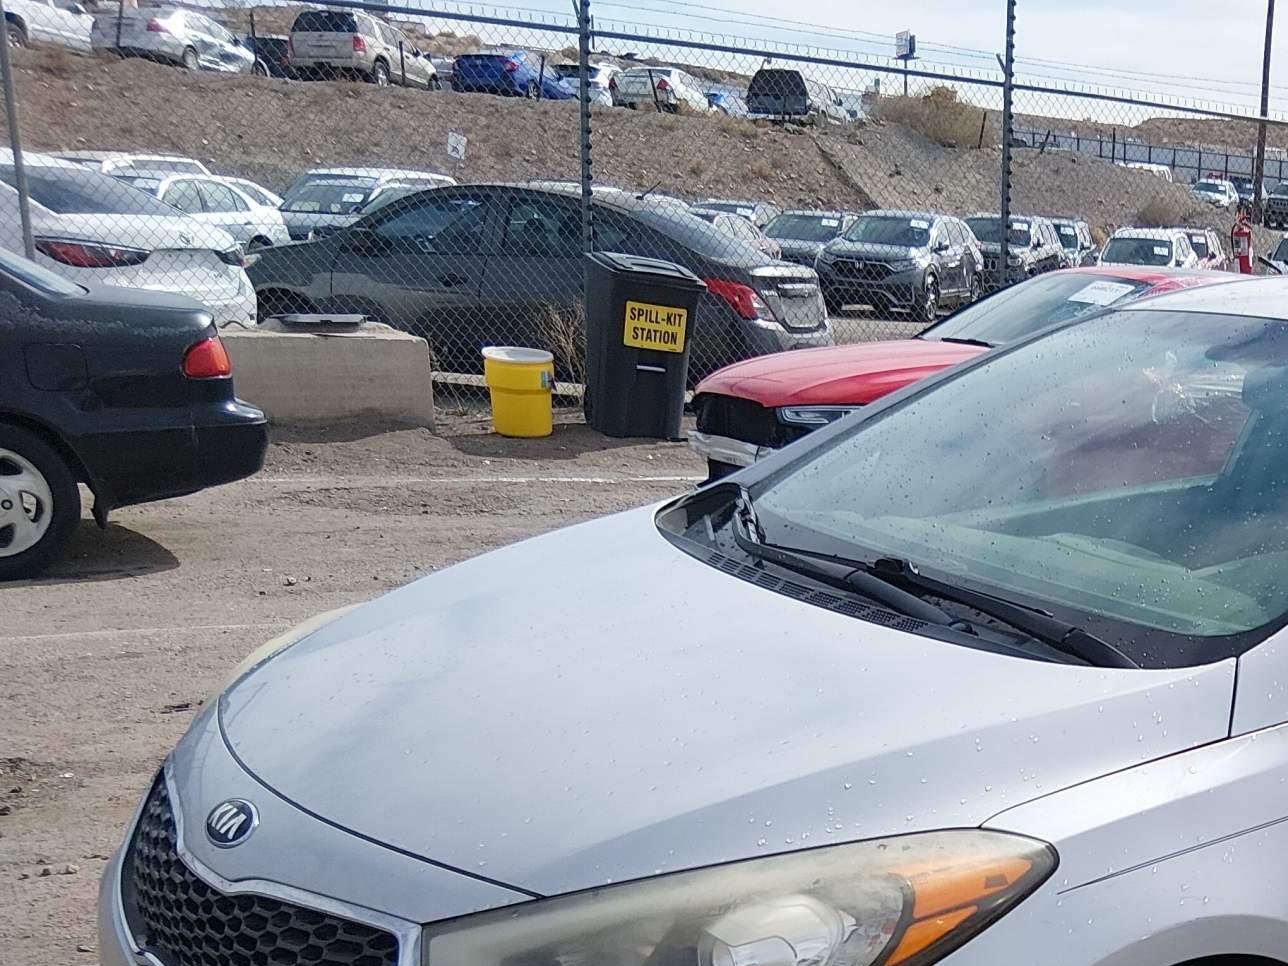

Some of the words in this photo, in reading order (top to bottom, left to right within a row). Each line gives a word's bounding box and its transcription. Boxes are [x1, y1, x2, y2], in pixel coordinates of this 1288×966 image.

[630, 306, 684, 327] SPILL-KIT
[631, 326, 678, 345] STATION
[207, 802, 248, 840] KIA
